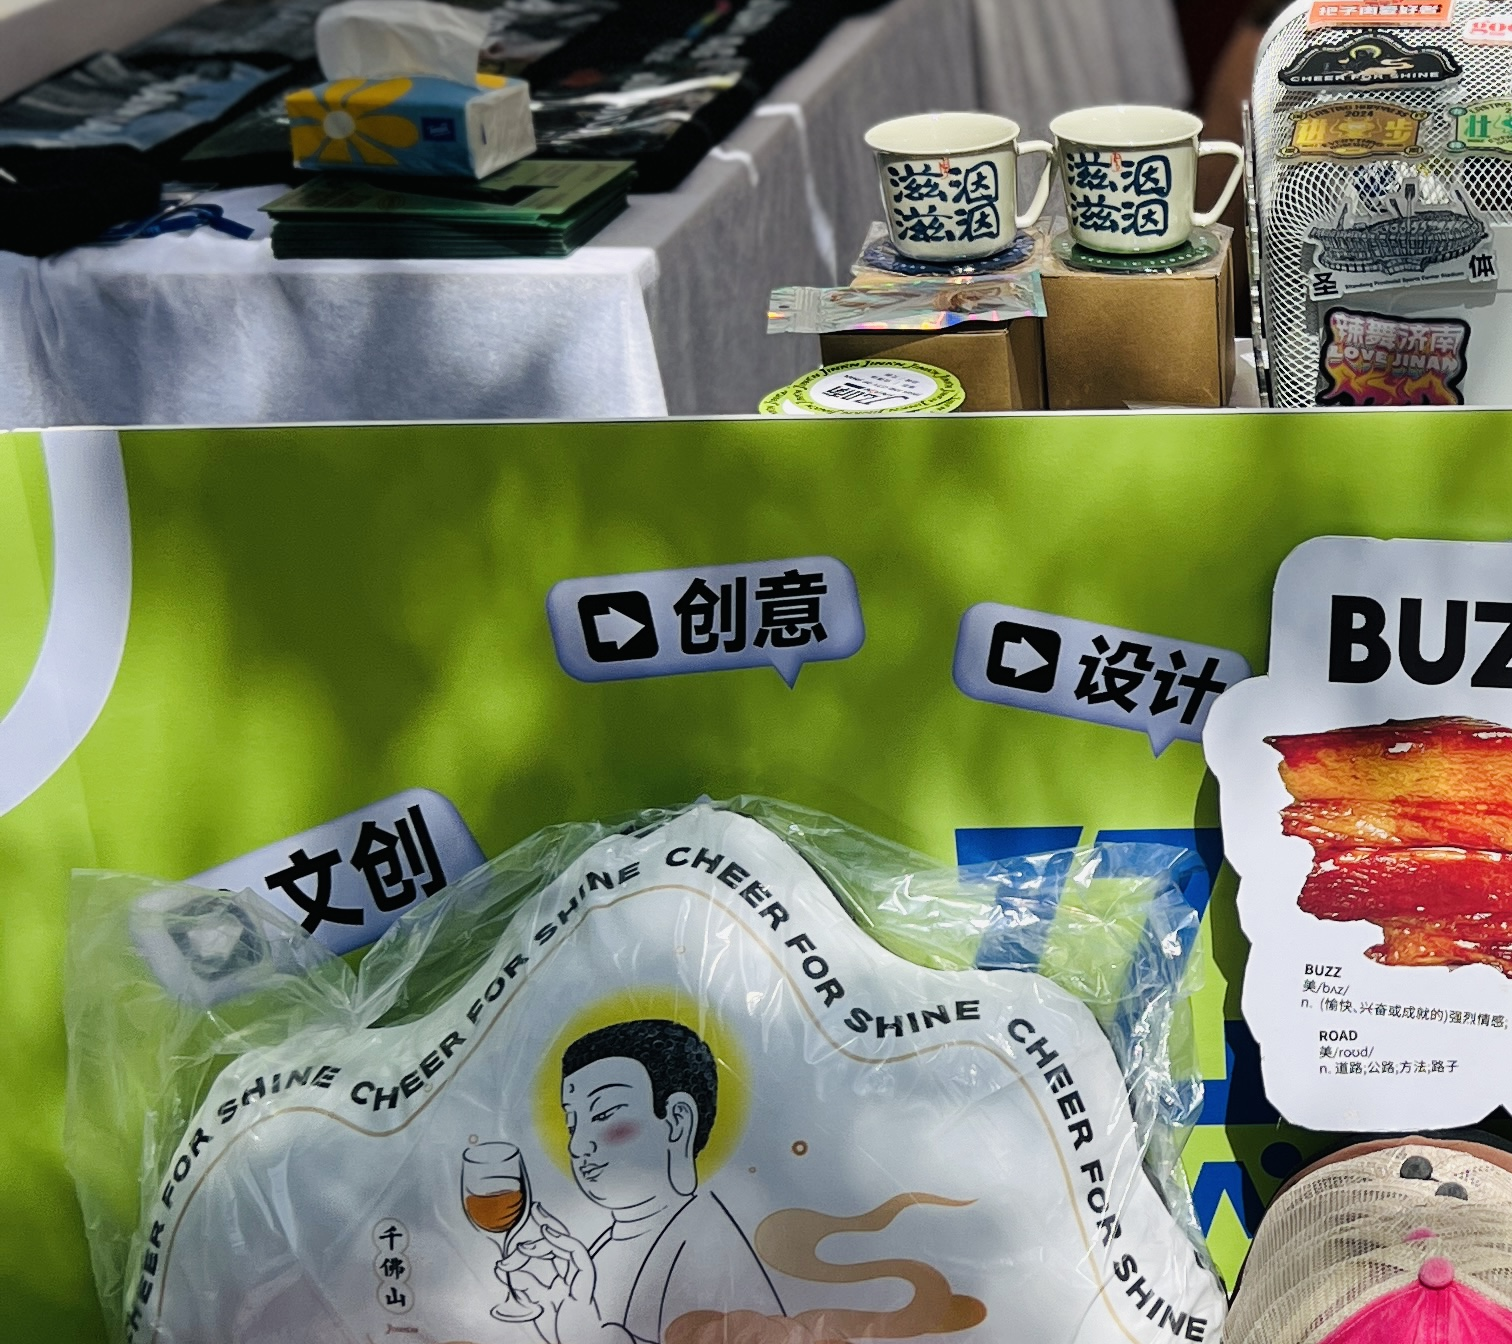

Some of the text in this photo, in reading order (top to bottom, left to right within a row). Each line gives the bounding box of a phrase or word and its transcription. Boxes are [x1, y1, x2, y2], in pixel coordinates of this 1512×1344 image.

[1389, 70, 1440, 80] SHINE
[1344, 110, 1374, 118] 2024
[1313, 253, 1495, 297] 圣 体
[1327, 346, 1458, 372] LOVE JINAN
[674, 569, 828, 655] 创意
[1075, 635, 1228, 726] 设计
[265, 805, 448, 934] 文创
[1304, 963, 1343, 979] BUZZ
[1318, 1029, 1358, 1042] ROAD
[1335, 1060, 1460, 1076] 道路;公路;方法;路子
[160, 1126, 214, 1214] FOR
[214, 1061, 342, 1125] SHINE
[348, 1028, 467, 1113] CHEER
[465, 955, 531, 1027] FOR
[532, 861, 642, 945] SHINE
[664, 846, 791, 931] CHEER
[784, 932, 847, 1010] FOR
[844, 998, 982, 1039] SHINE
[1005, 1016, 1096, 1153] CHEER
[1078, 1160, 1124, 1247] FOR
[1112, 1250, 1209, 1344] SHINE
[379, 1225, 406, 1307] 千佛山
